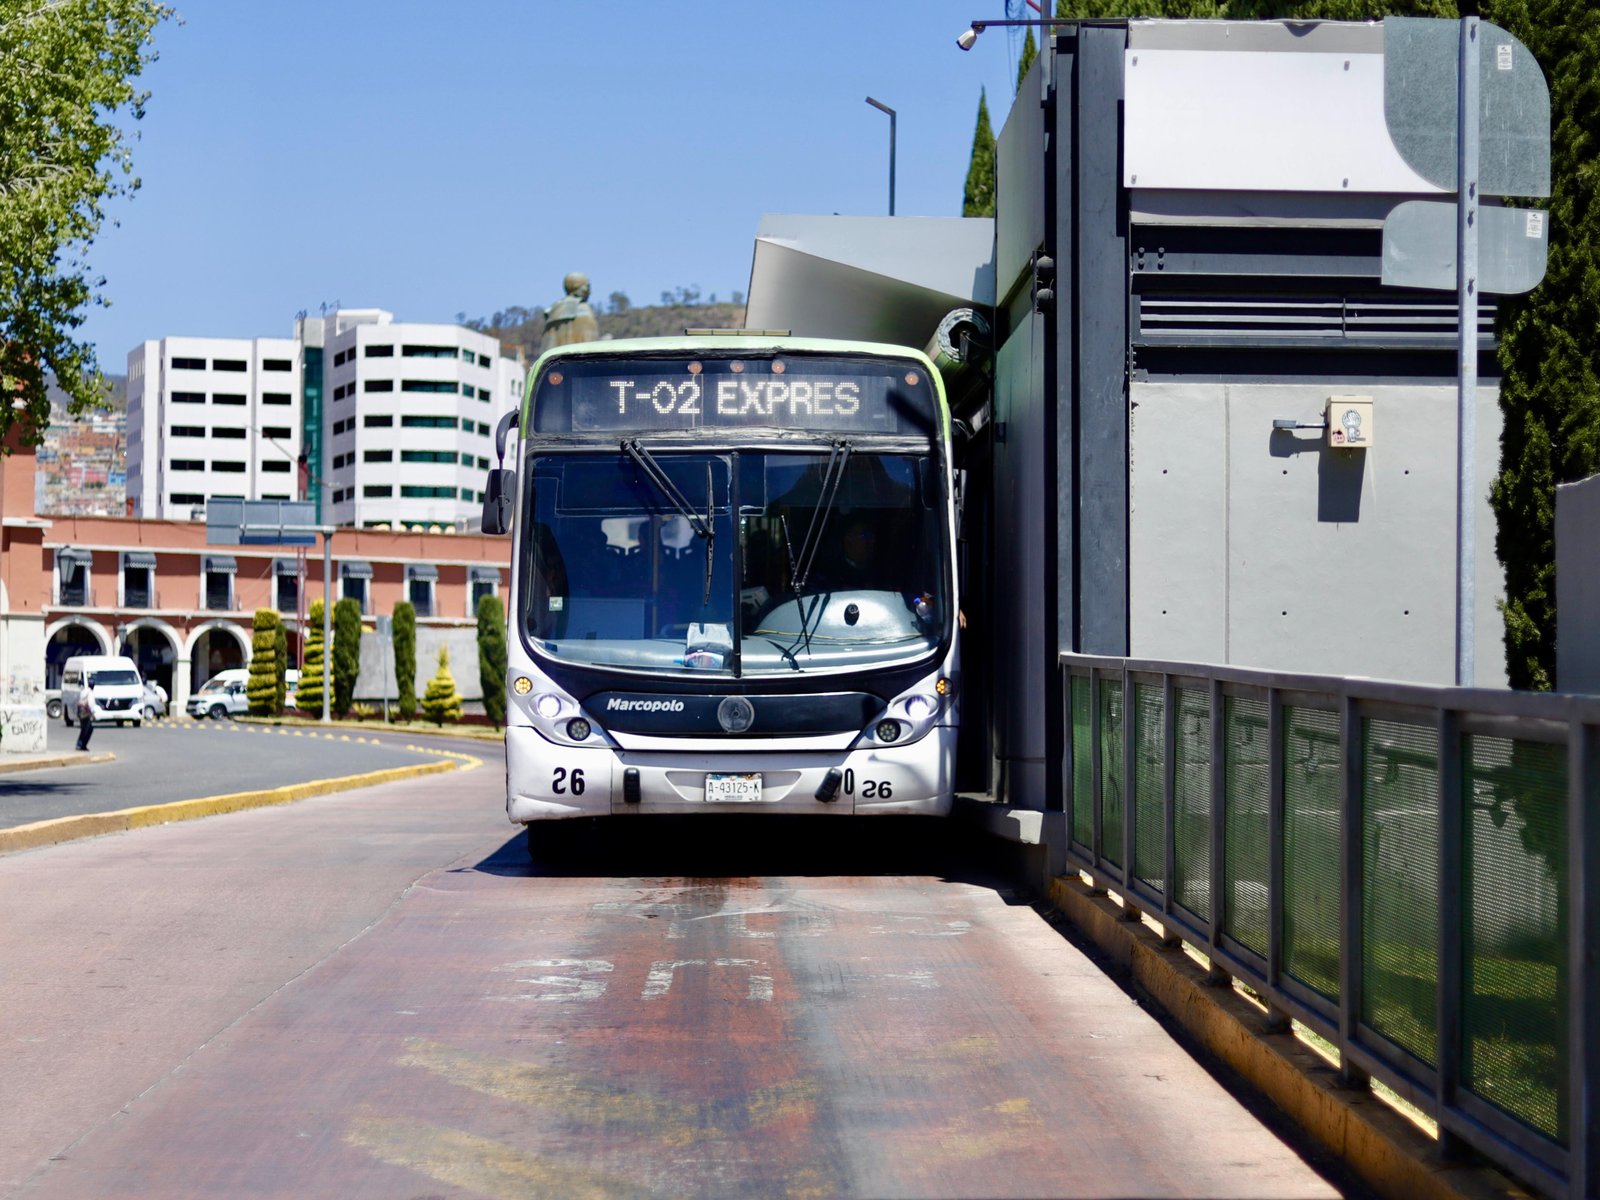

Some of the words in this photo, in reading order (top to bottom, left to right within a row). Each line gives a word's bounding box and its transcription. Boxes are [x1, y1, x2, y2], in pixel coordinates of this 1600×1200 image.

[609, 380, 701, 414] T-02
[716, 381, 860, 415] EXPRES
[606, 697, 685, 713] Marcopolo
[551, 766, 586, 796] 26
[707, 781, 760, 794] A-43125-K
[861, 779, 893, 799] 26
